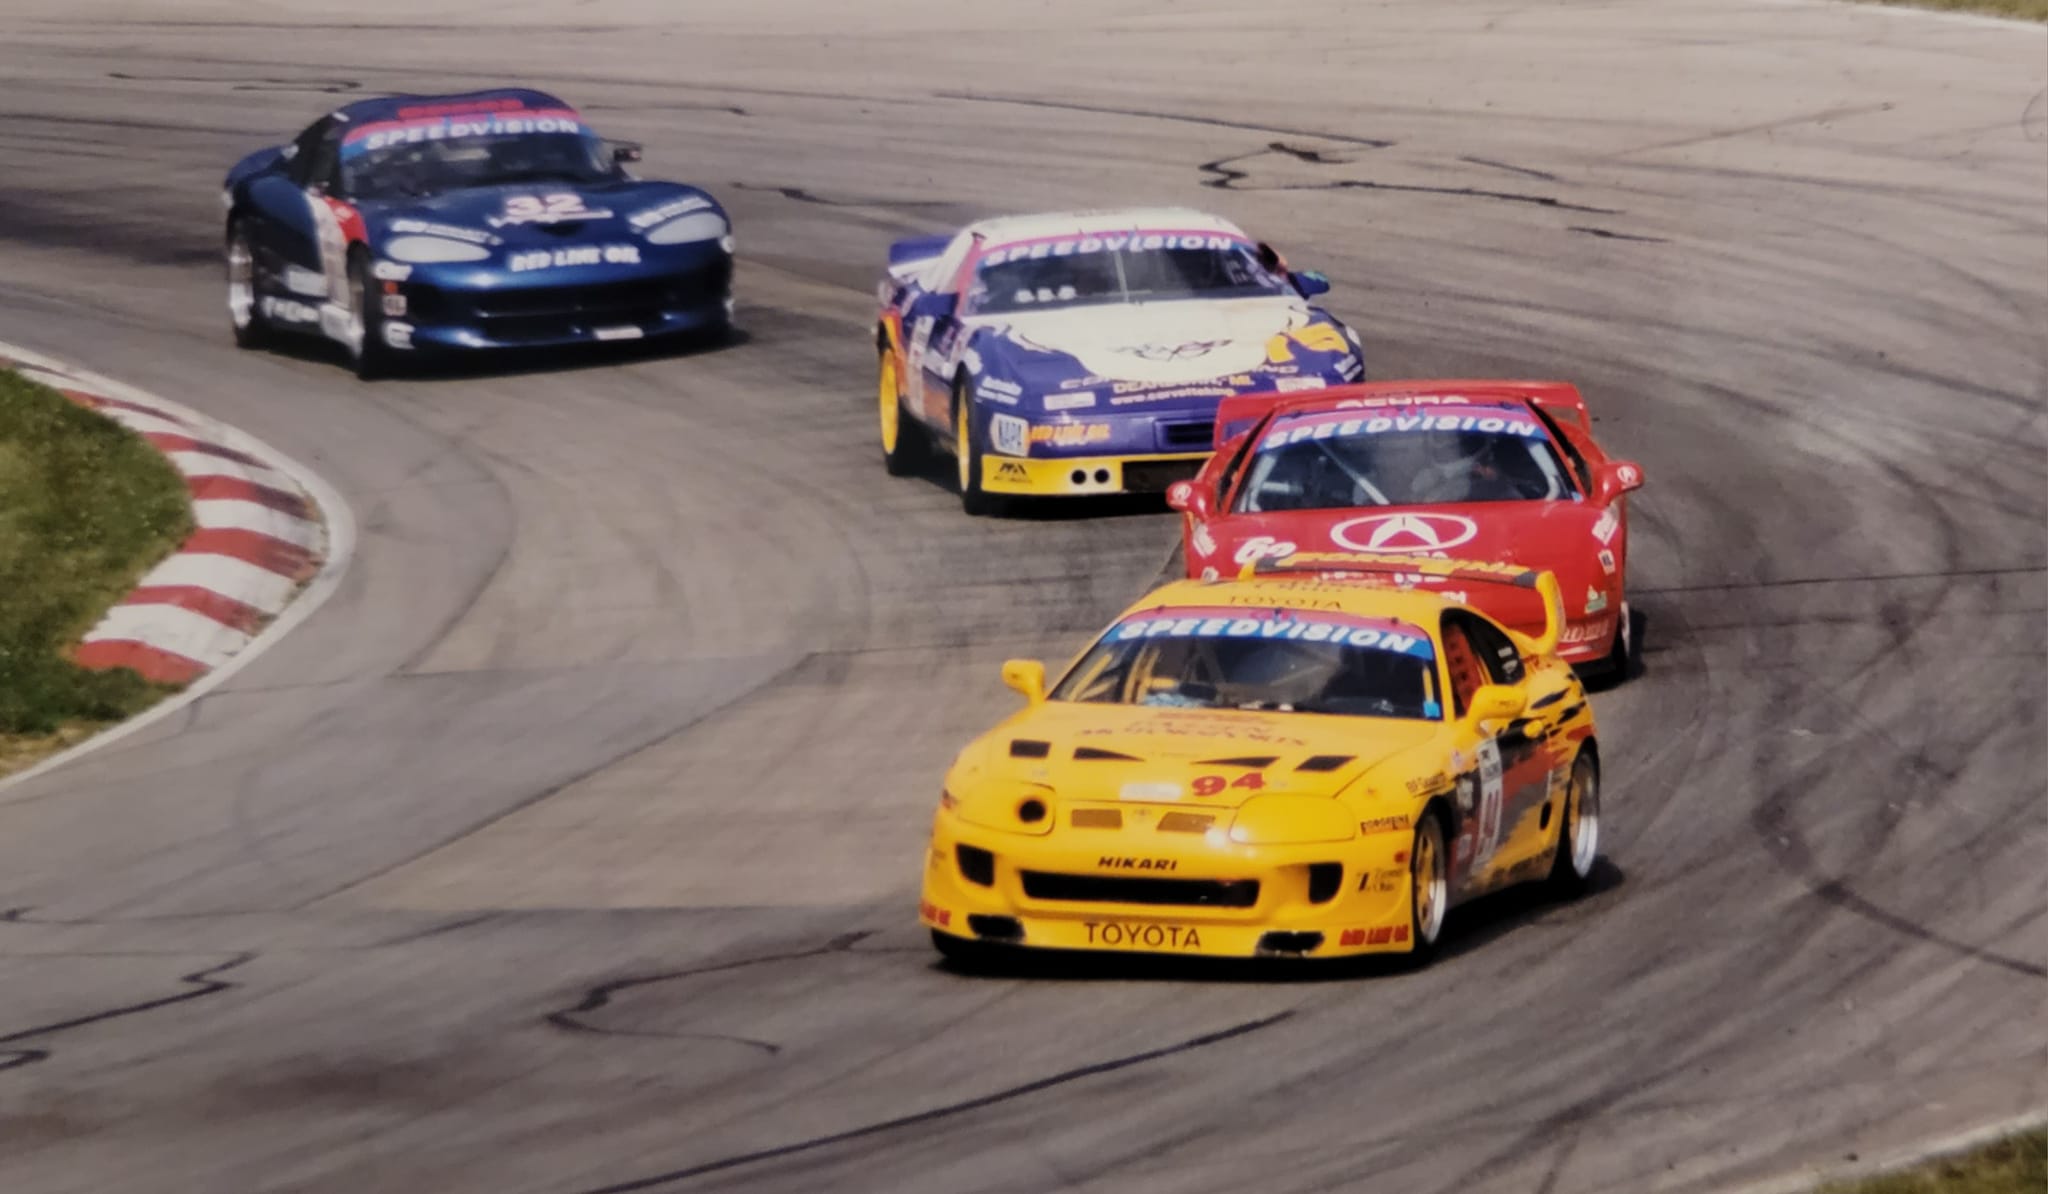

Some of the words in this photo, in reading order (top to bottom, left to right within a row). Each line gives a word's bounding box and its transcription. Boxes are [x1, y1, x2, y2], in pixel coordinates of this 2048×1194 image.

[366, 118, 580, 150] SPEEDVISION
[506, 193, 587, 217] 32
[508, 250, 552, 272] RED
[554, 247, 602, 267] LINE
[603, 245, 641, 265] OIL
[984, 235, 1233, 267] SPEEDVISION
[998, 420, 1022, 447] NAPA
[1263, 412, 1538, 450] SPEEDVISION
[1229, 595, 1342, 610] TOYOTA
[1117, 616, 1417, 654] SPEEDVISION
[1190, 772, 1266, 797] 94
[1098, 856, 1178, 872] HIKARI
[1083, 921, 1202, 948] TOYOTA
